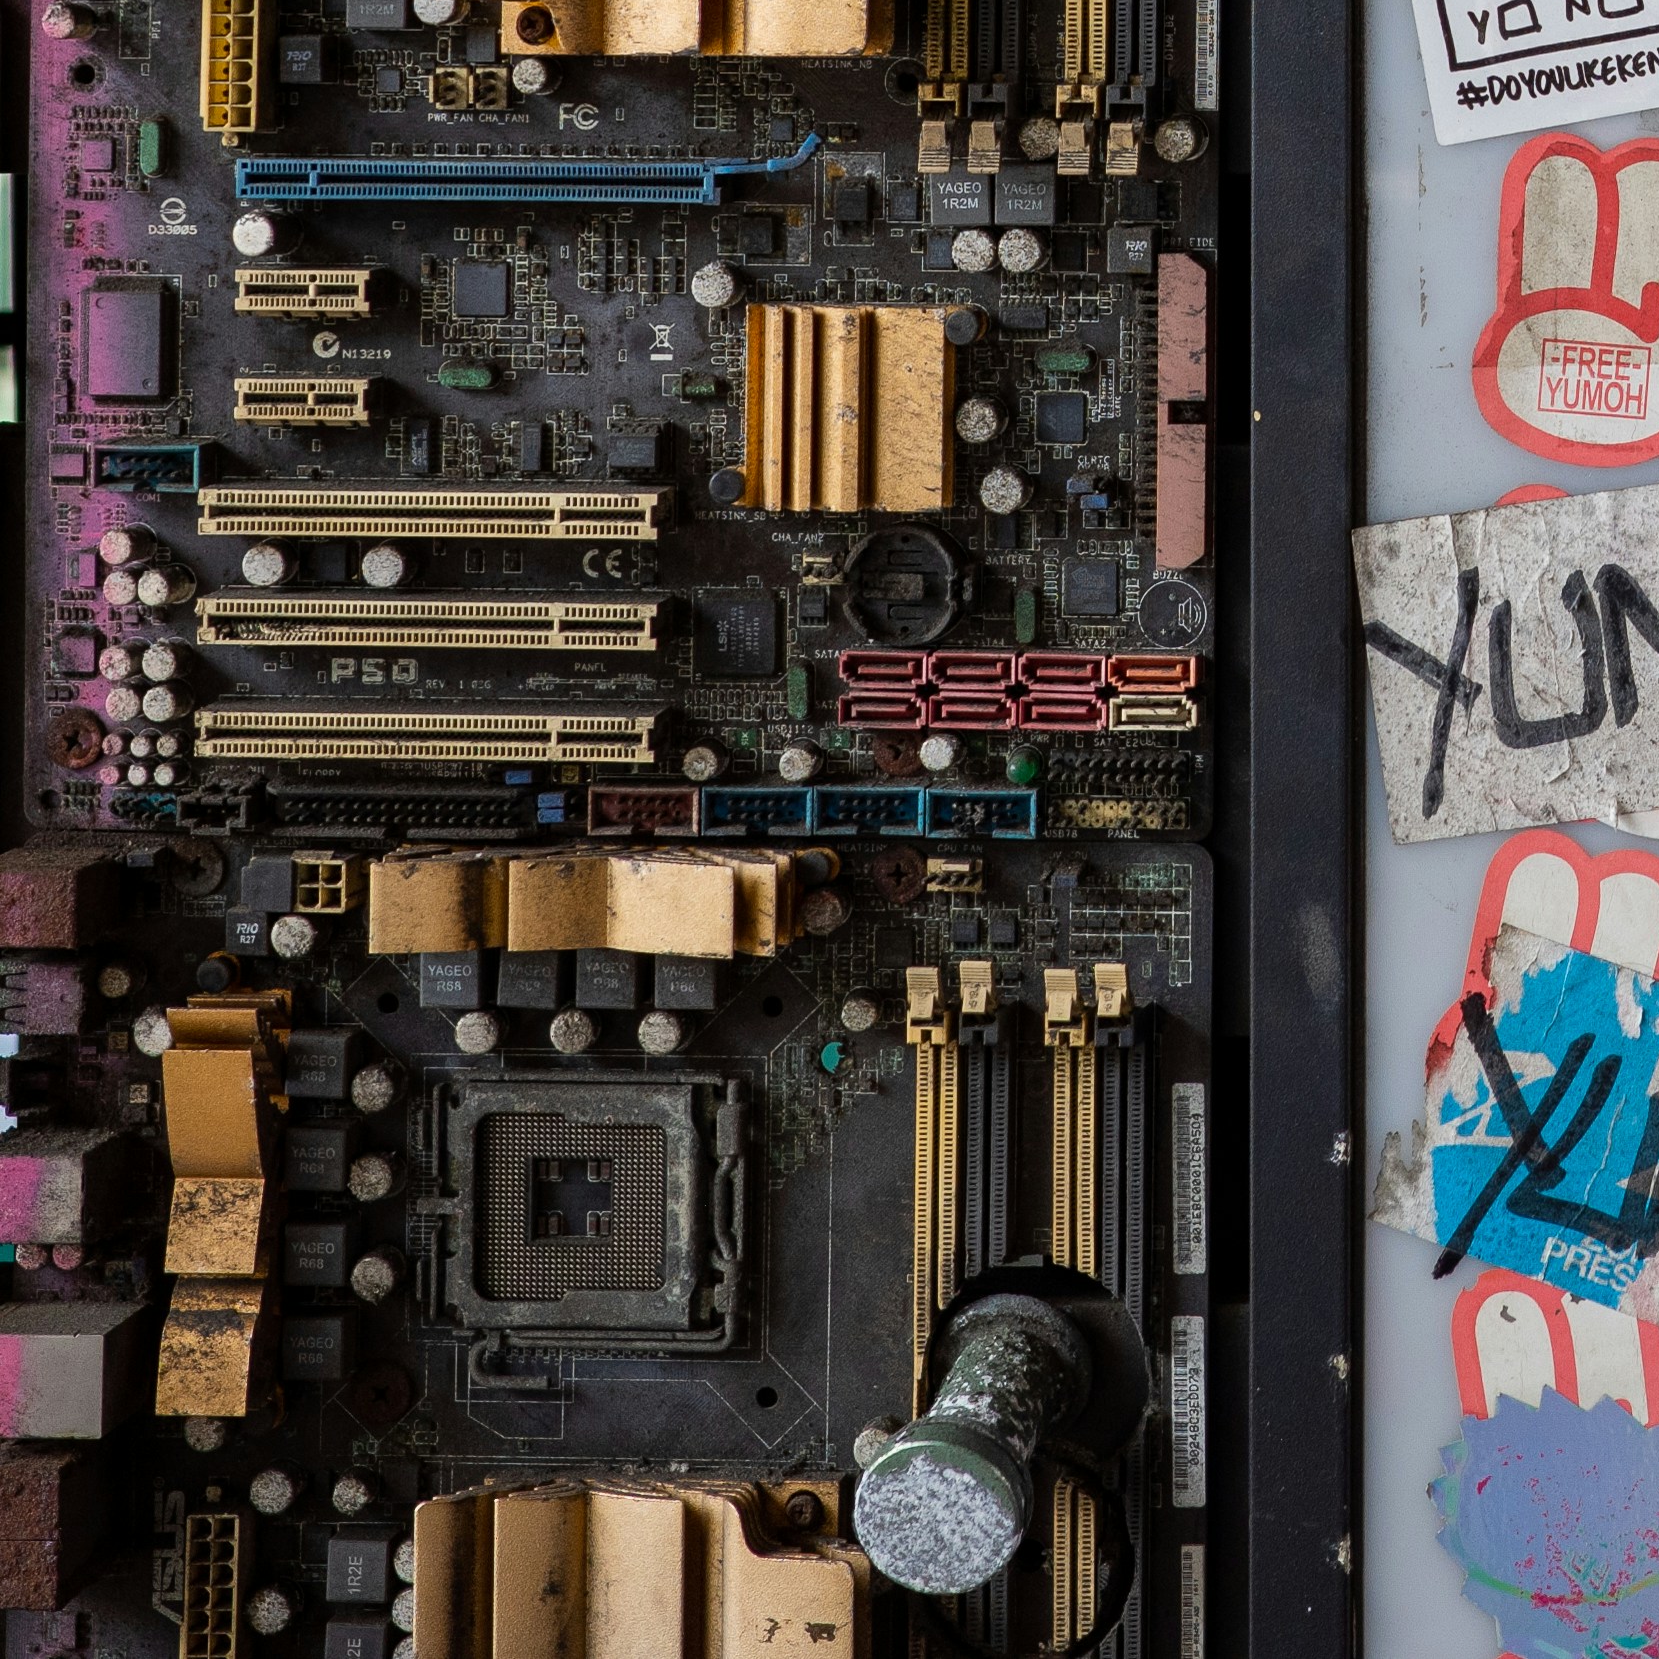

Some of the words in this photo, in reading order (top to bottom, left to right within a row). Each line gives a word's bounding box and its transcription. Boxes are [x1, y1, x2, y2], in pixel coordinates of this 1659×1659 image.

[1164, 15, 1175, 61] DIMM_B2
[426, 112, 474, 124] PWR_FAN
[478, 112, 530, 124] CHA_FAN1
[937, 182, 982, 194] YAGEO
[1001, 182, 1046, 195] YAGEO
[942, 197, 980, 210] 1R2M
[1006, 198, 1043, 210] 1R2M
[341, 349, 392, 360] N13219
[1550, 343, 1643, 382] -FREE-
[1546, 376, 1645, 417] YUMOH
[135, 492, 161, 502] COM1
[574, 662, 607, 673] PANEL
[425, 679, 445, 690] REV
[1194, 754, 1204, 774] TPM
[1107, 829, 1140, 840] PANEL
[239, 935, 256, 945] R27
[428, 964, 472, 976] YAGEO
[437, 981, 462, 992] R68
[293, 1054, 337, 1067] YAGEO
[301, 1069, 326, 1082] R68
[292, 1147, 336, 1160] YAGEO
[291, 1242, 335, 1255] YAGEO
[299, 1257, 324, 1269] R68
[291, 1337, 334, 1349] YAGEO
[298, 1352, 324, 1364] R68
[151, 1489, 186, 1623] ASUS
[347, 1555, 363, 1595] 1R2E
